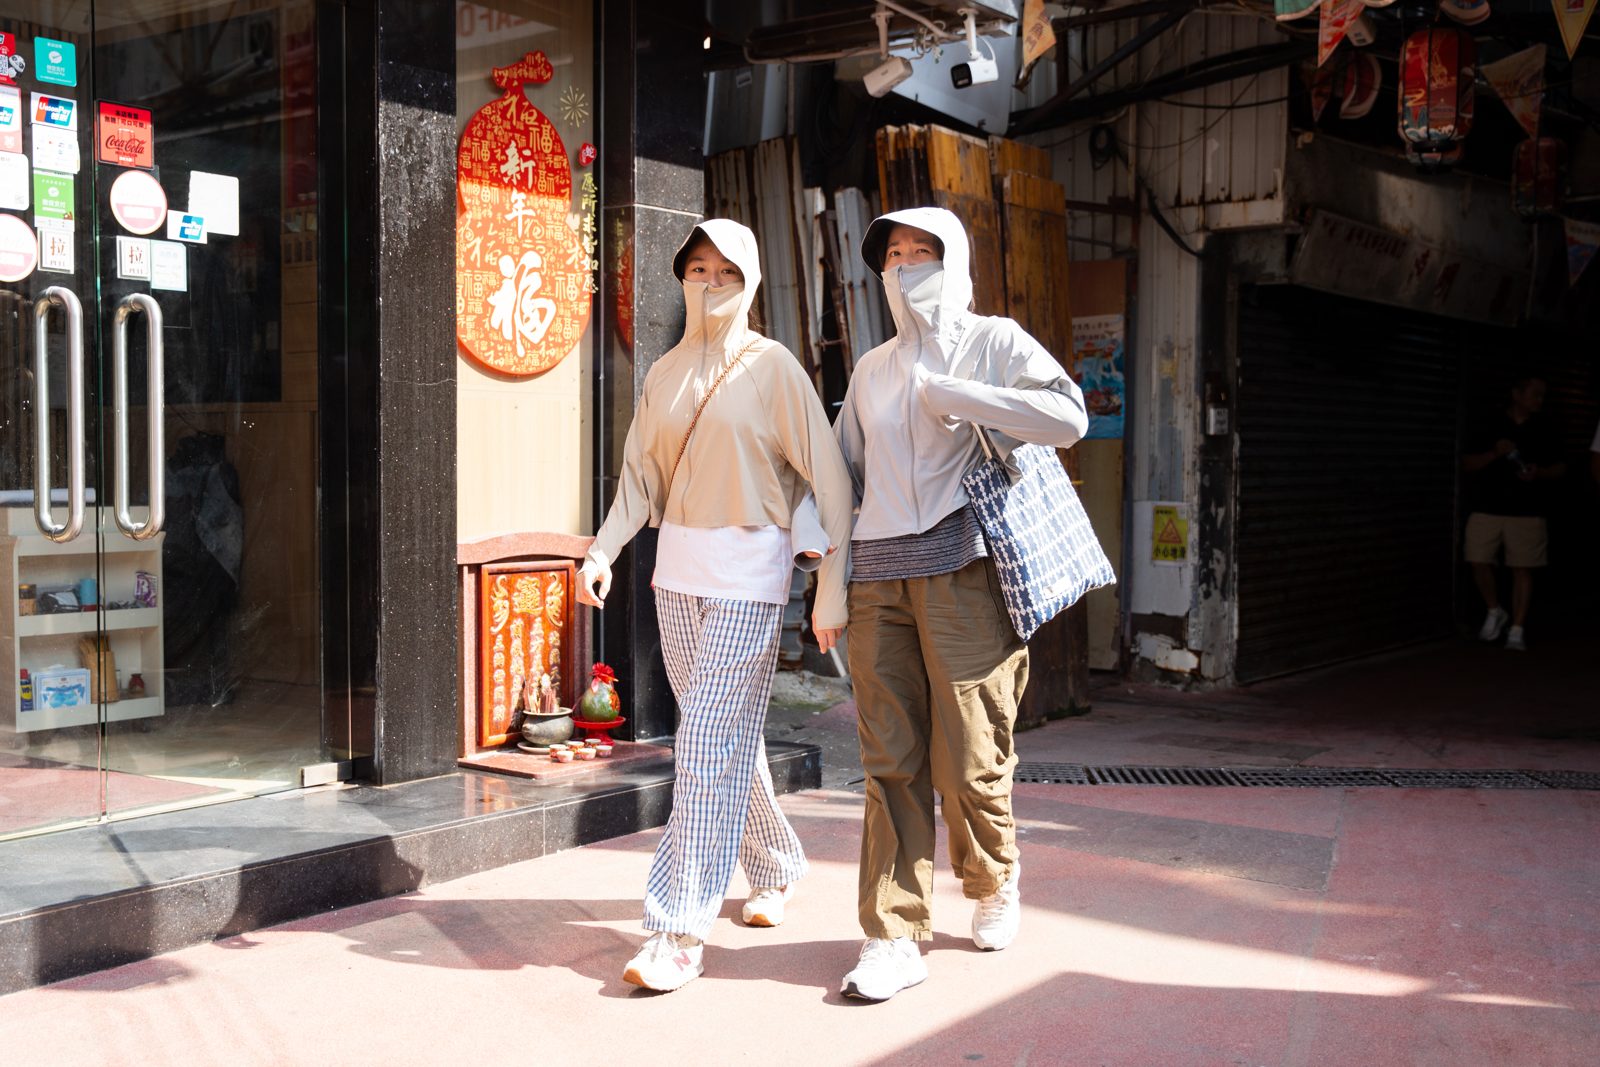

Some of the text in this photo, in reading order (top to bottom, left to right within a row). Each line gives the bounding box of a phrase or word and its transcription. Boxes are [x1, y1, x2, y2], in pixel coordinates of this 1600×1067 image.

[500, 140, 536, 239] 新年
[50, 236, 66, 257] 拉
[128, 245, 144, 265] 拉
[487, 250, 557, 358] 福
